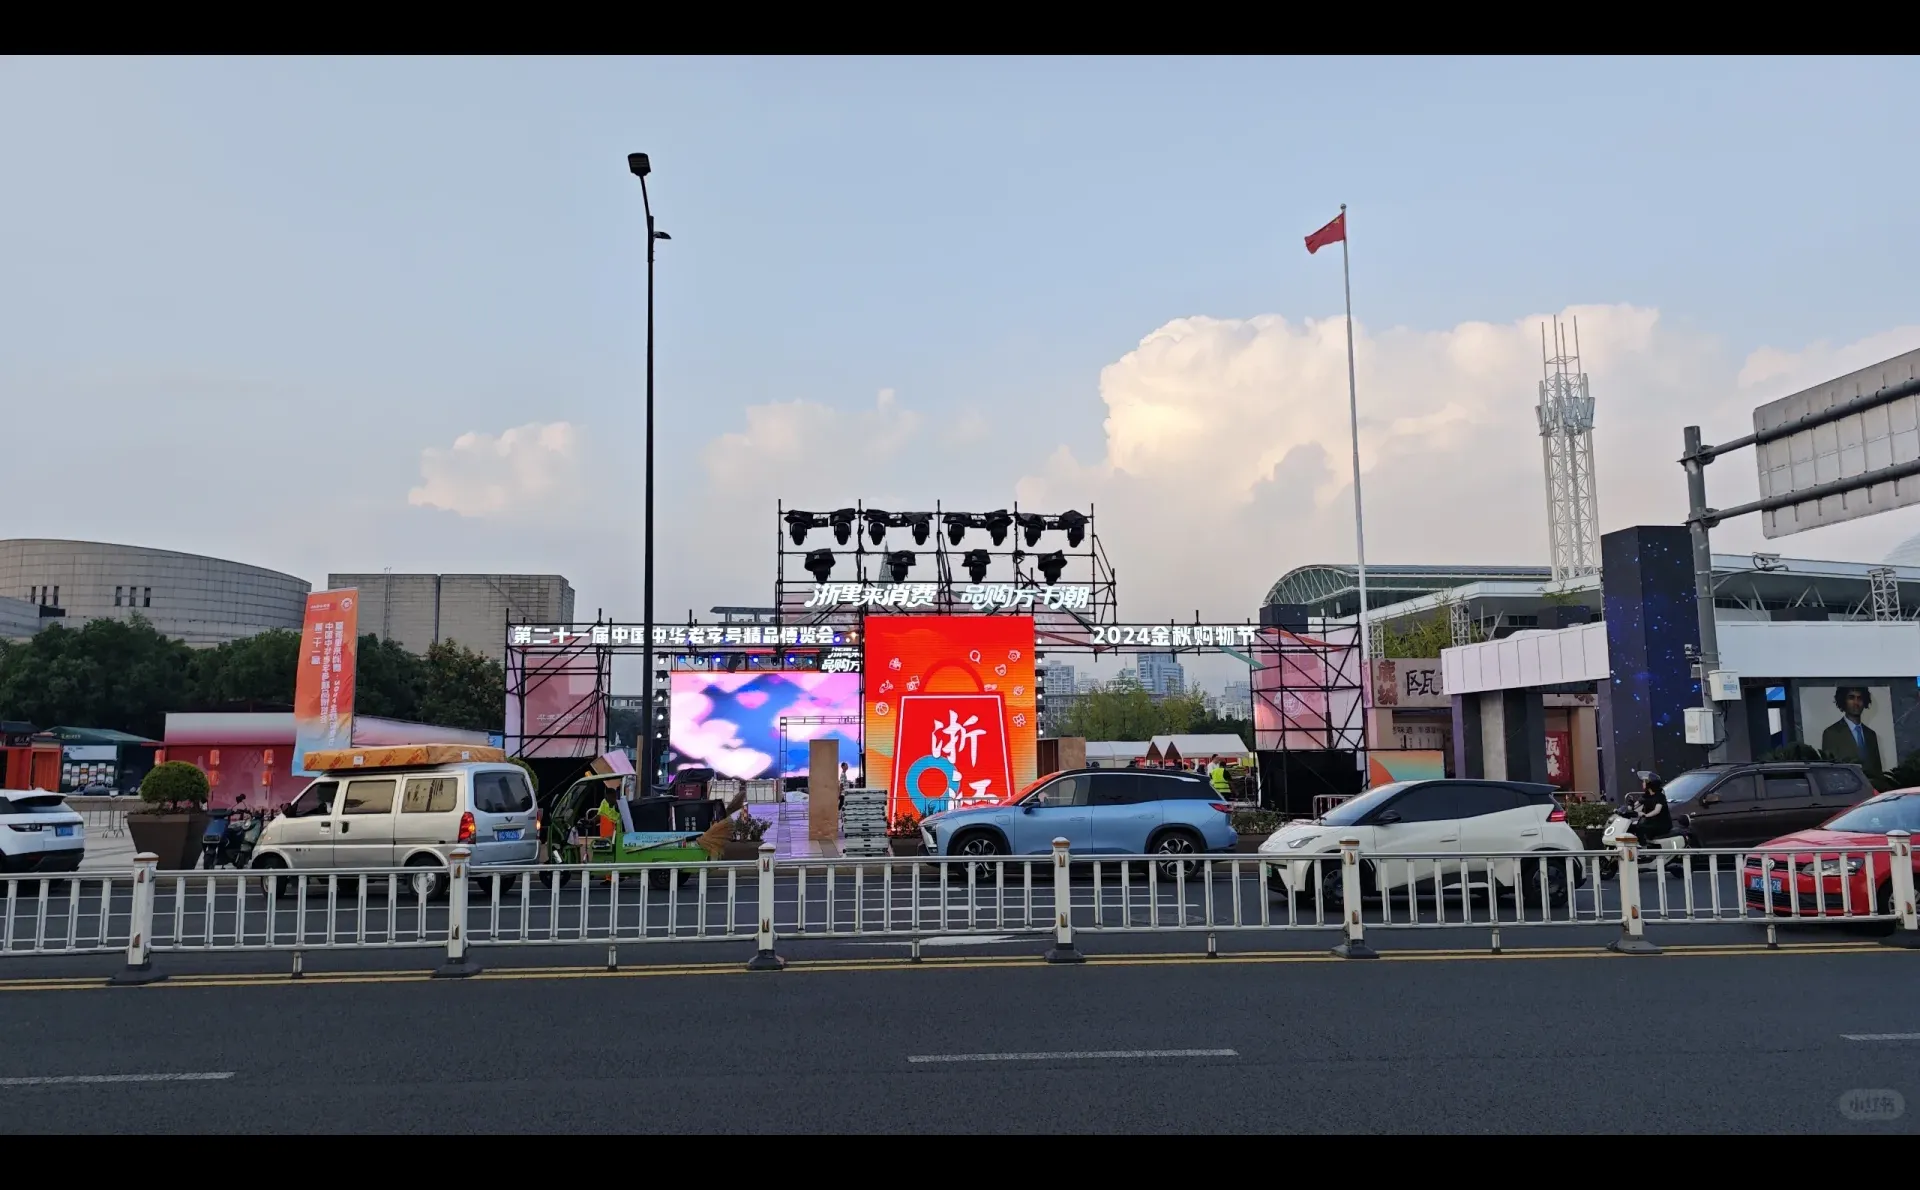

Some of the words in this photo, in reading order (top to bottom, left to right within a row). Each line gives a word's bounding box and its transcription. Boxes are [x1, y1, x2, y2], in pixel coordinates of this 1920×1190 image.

[804, 583, 938, 608] 浙里来消费
[960, 583, 1090, 610] 品购万千潮
[514, 626, 834, 644] 第二十一届中国中华老字号精品博览会
[1093, 626, 1256, 646] 2024金秋购物节
[1406, 670, 1444, 696] 瓯
[932, 709, 999, 811] 浙江
